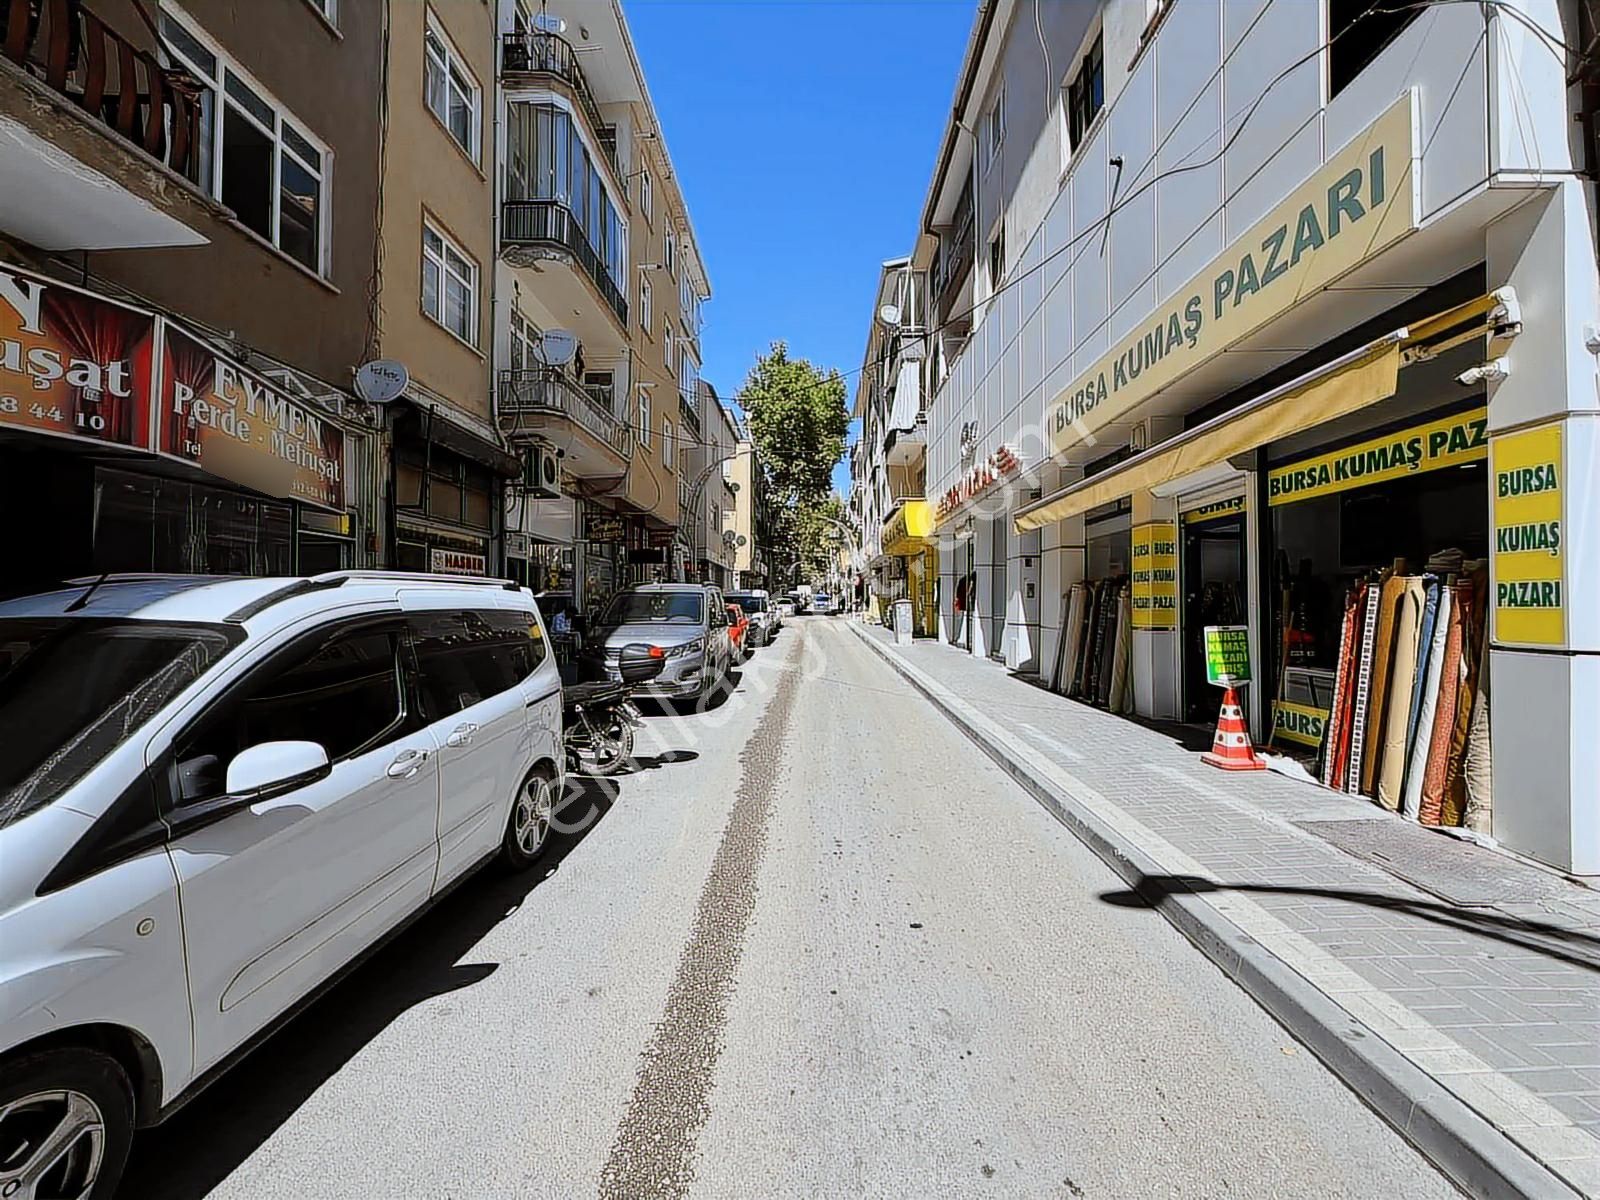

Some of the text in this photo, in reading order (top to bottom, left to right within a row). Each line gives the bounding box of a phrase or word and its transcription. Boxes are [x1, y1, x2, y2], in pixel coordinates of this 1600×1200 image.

[1055, 144, 1385, 434] BURSA KUMAŞ PAZARI
[28, 402, 64, 421] 44
[75, 412, 105, 430] 10
[213, 357, 322, 449] EYMEN
[173, 380, 250, 442] Perde
[270, 430, 341, 483] Mefruşat
[1269, 463, 1331, 498] BURSA
[1334, 437, 1422, 471] KUMAŞ
[1497, 463, 1557, 498] BURSA
[1496, 521, 1560, 557] KUMAŞ
[1496, 580, 1561, 608] PAZARI
[1208, 631, 1246, 641] BURSA
[1209, 652, 1247, 663] PAZARI
